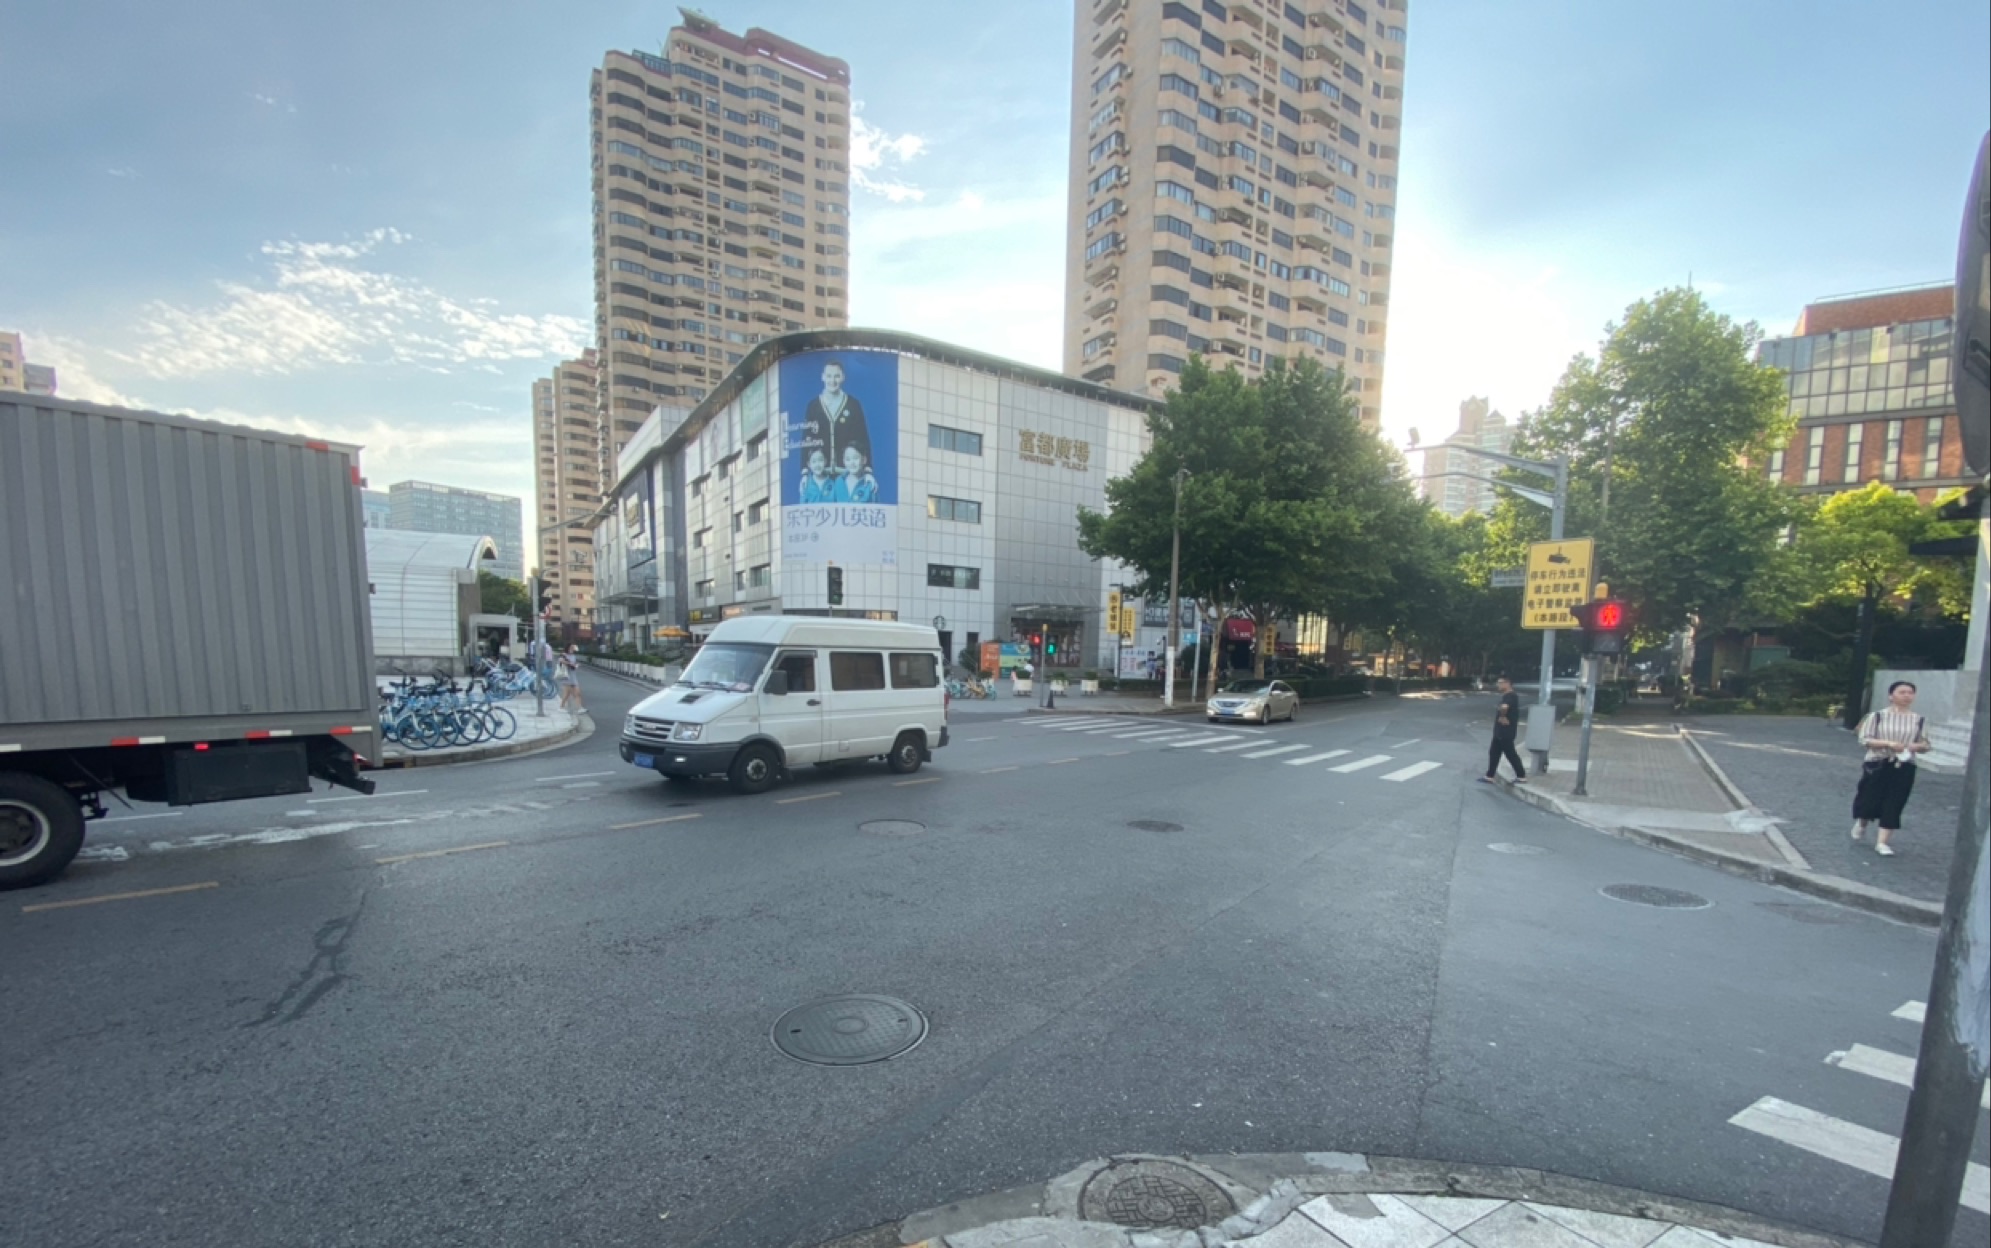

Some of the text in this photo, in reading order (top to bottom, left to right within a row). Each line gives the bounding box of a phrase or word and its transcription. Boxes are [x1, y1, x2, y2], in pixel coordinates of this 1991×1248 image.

[1018, 429, 1090, 463] 富都廣場
[786, 506, 886, 529] 乐宁少儿英语
